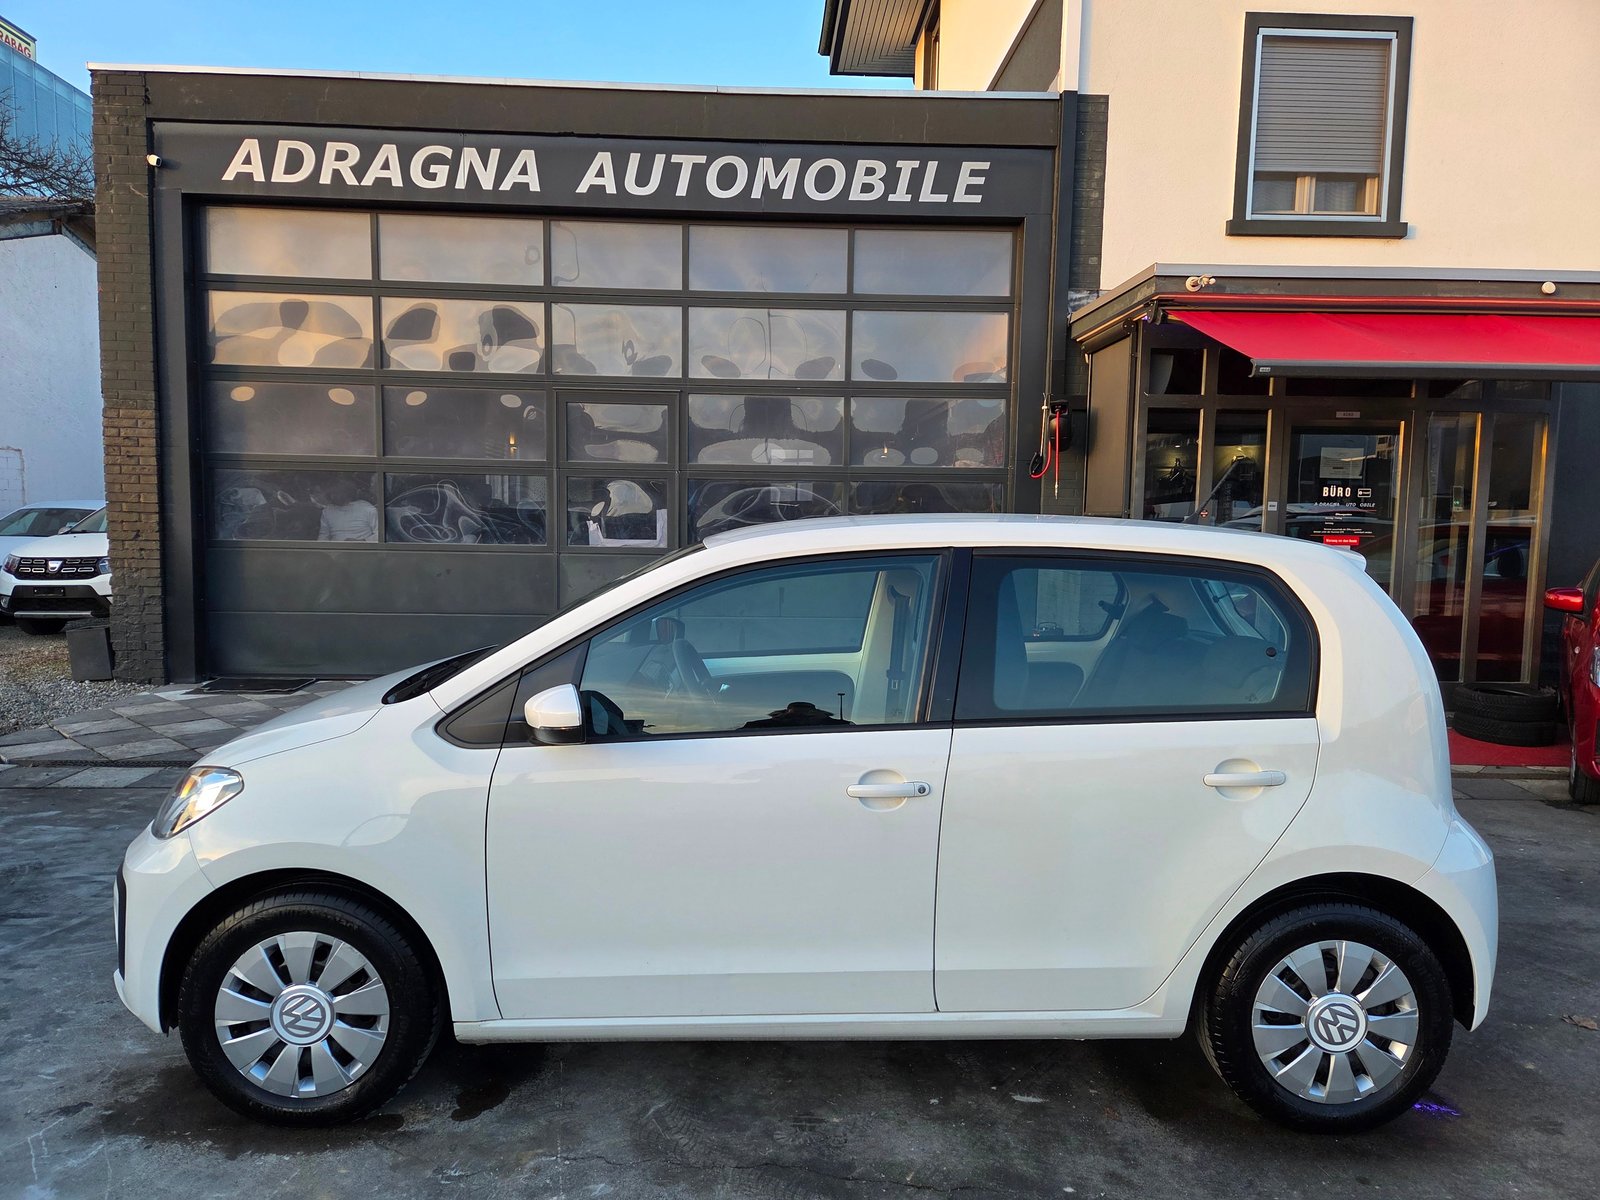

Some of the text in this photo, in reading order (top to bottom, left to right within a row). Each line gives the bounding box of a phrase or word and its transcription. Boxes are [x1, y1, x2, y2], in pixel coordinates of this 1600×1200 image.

[221, 138, 991, 203] ADRAGNA AUTOMOBILE
[1322, 485, 1351, 497] BÜRO
[277, 992, 328, 1040] VW
[1312, 1001, 1362, 1047] VW
